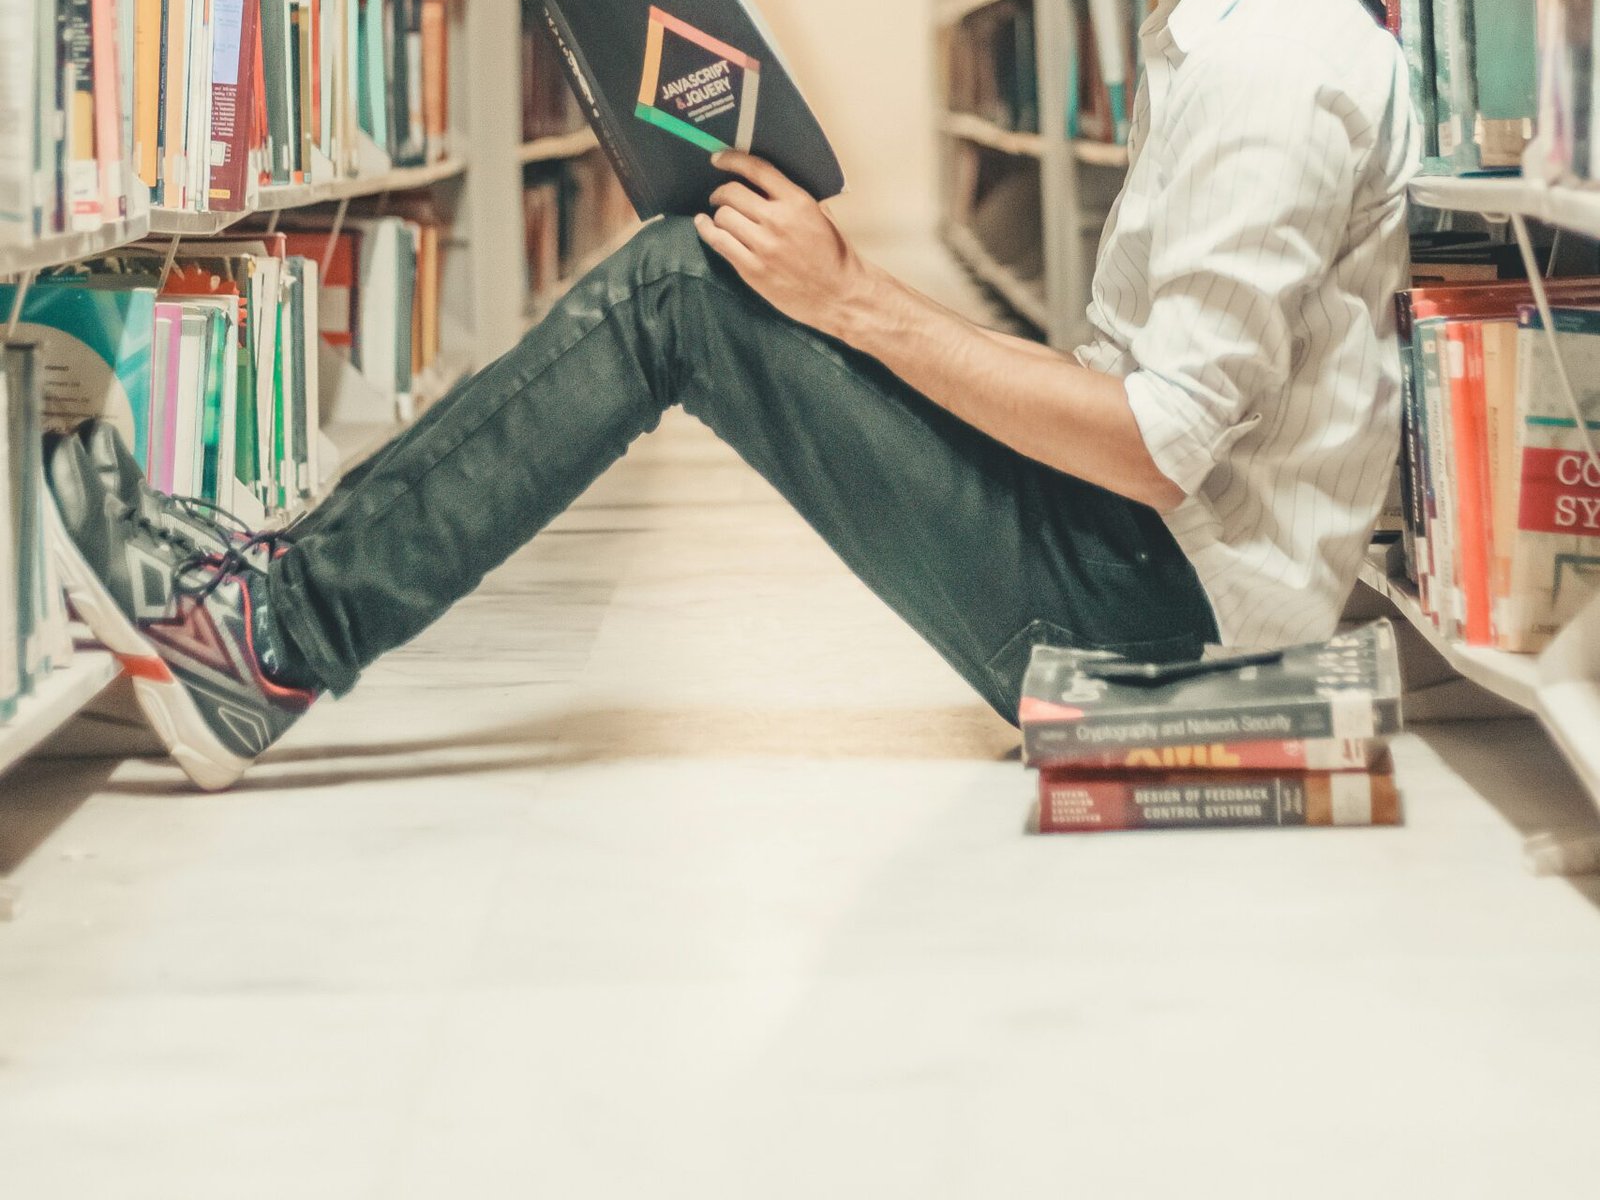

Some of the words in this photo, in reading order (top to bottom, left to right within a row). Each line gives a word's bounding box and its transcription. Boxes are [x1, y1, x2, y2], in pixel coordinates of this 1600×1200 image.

[662, 60, 730, 100] JAVASCRIPT
[675, 95, 687, 110] &
[686, 77, 731, 107] JQUERY
[1555, 495, 1600, 528] SY
[1076, 722, 1157, 743] Cryptography
[1160, 720, 1185, 737] and
[1187, 717, 1237, 735] Network
[1241, 713, 1291, 732] Security
[1134, 791, 1180, 804] DESIGN
[1186, 790, 1201, 803] OF
[1205, 787, 1268, 802] FEEDBACK
[1143, 806, 1200, 820] CONTROL
[1205, 804, 1262, 818] SYSTEMS
